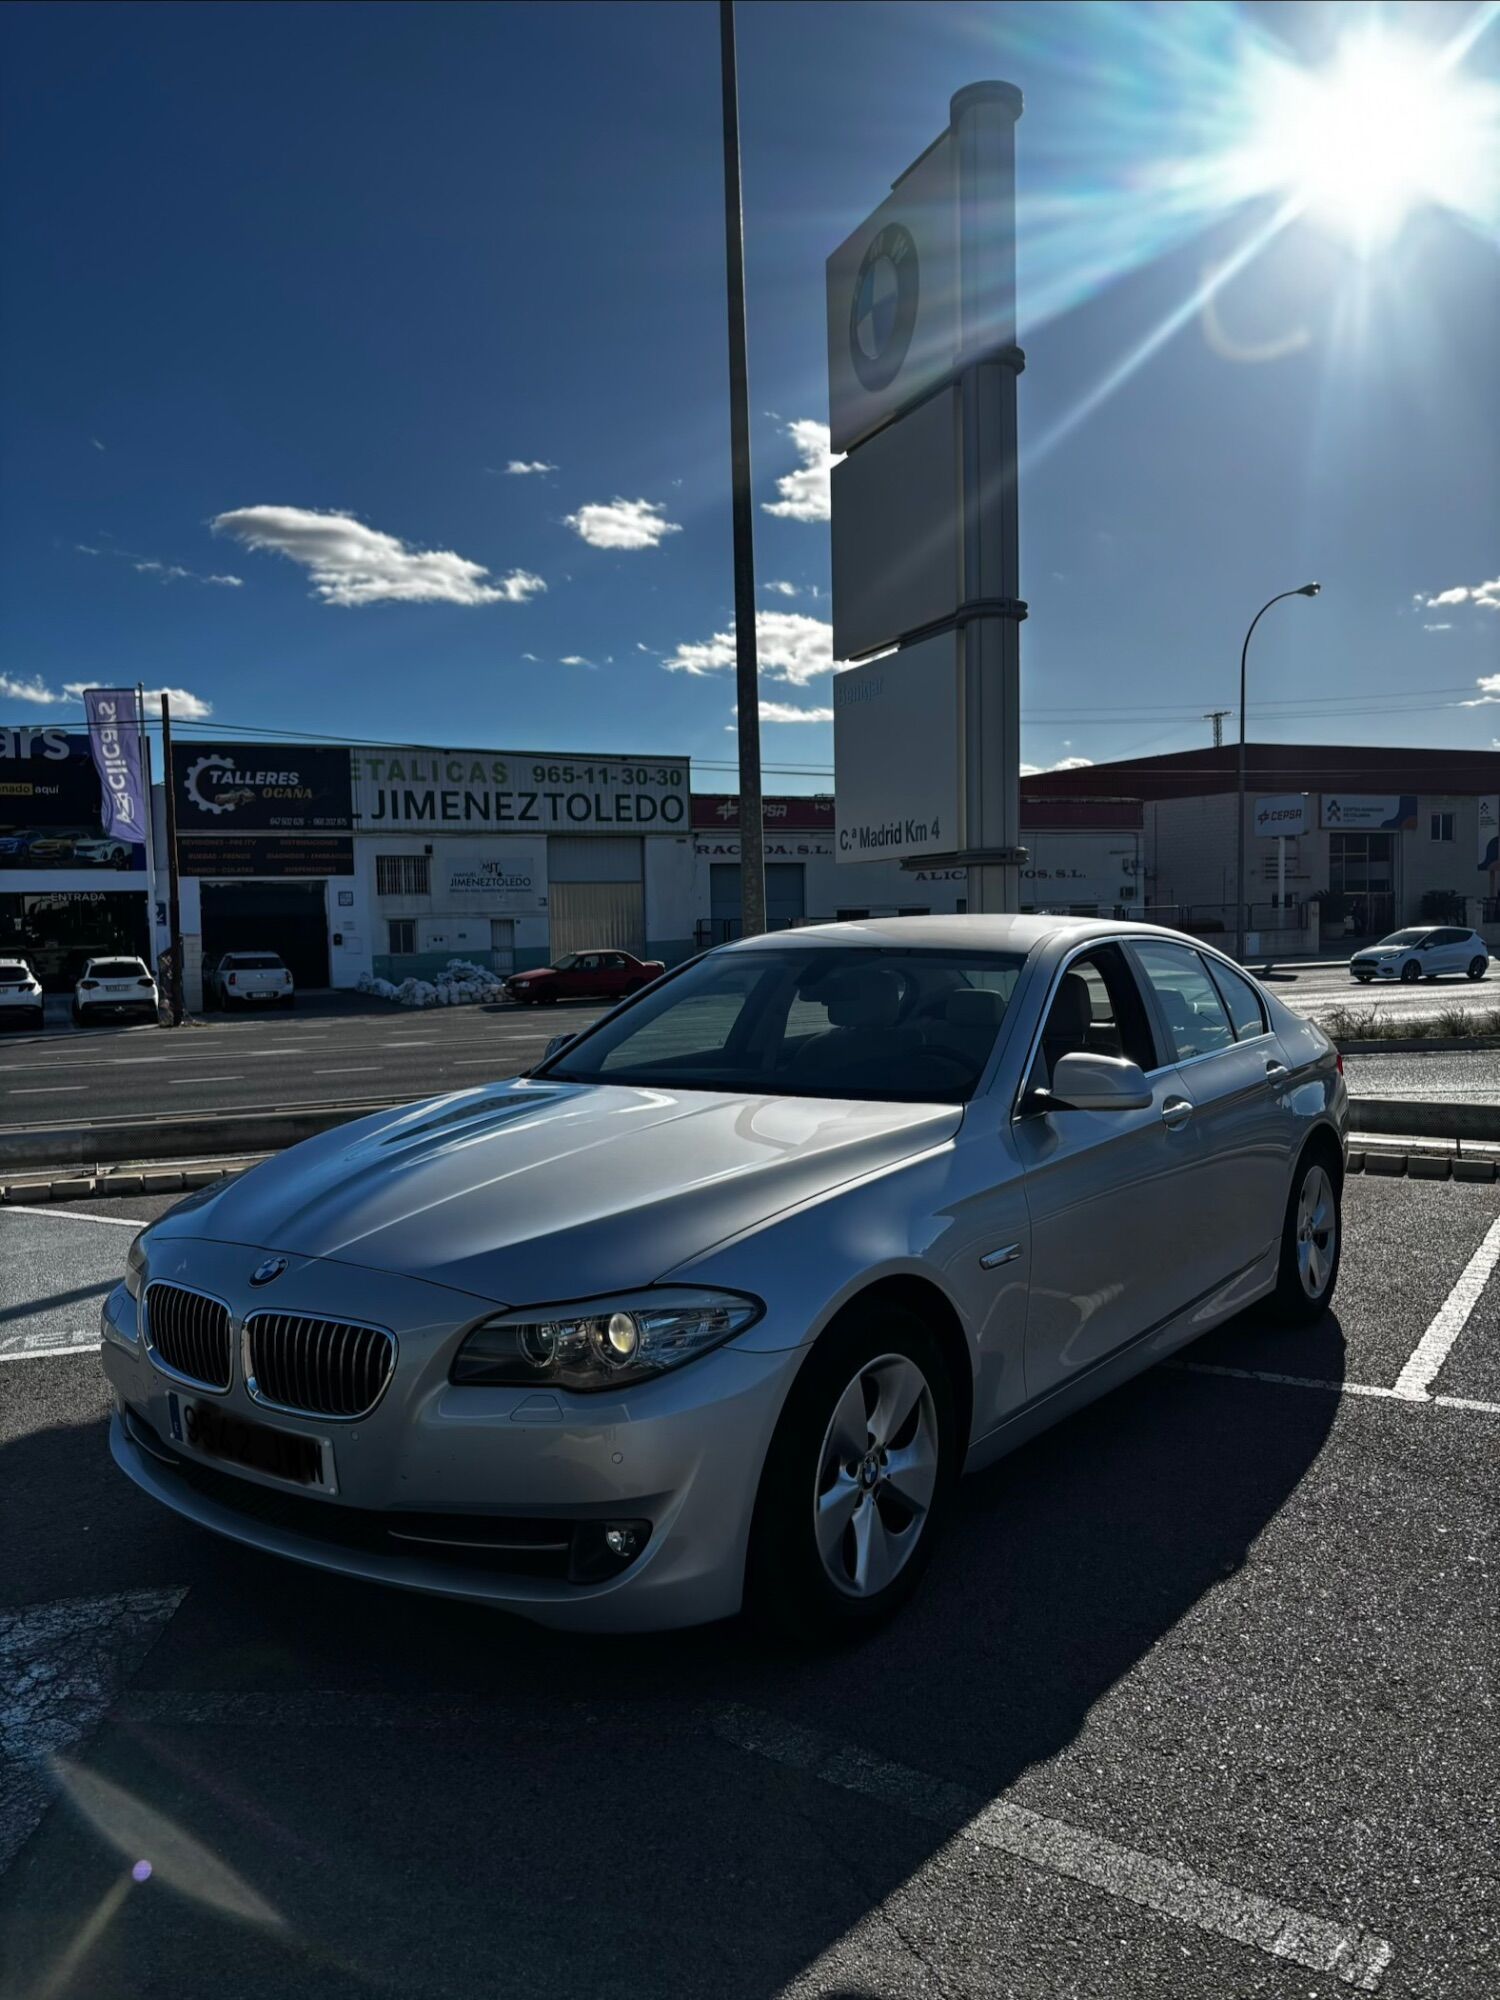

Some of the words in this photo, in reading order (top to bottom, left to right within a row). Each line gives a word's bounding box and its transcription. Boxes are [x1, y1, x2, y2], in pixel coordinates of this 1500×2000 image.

[209, 770, 300, 785] TALLERES
[352, 758, 509, 784] ETALICAS
[533, 766, 682, 786] 965-11-30-30
[35, 784, 59, 796] aquí
[262, 785, 312, 799] OCAÑA
[1271, 809, 1302, 821] CEPSA
[860, 823, 902, 848] Madrid
[905, 819, 928, 844] Km
[931, 816, 940, 839] 4
[797, 845, 832, 854] S.L.
[1055, 869, 1087, 879] S.L.
[50, 892, 106, 902] ENTRADA
